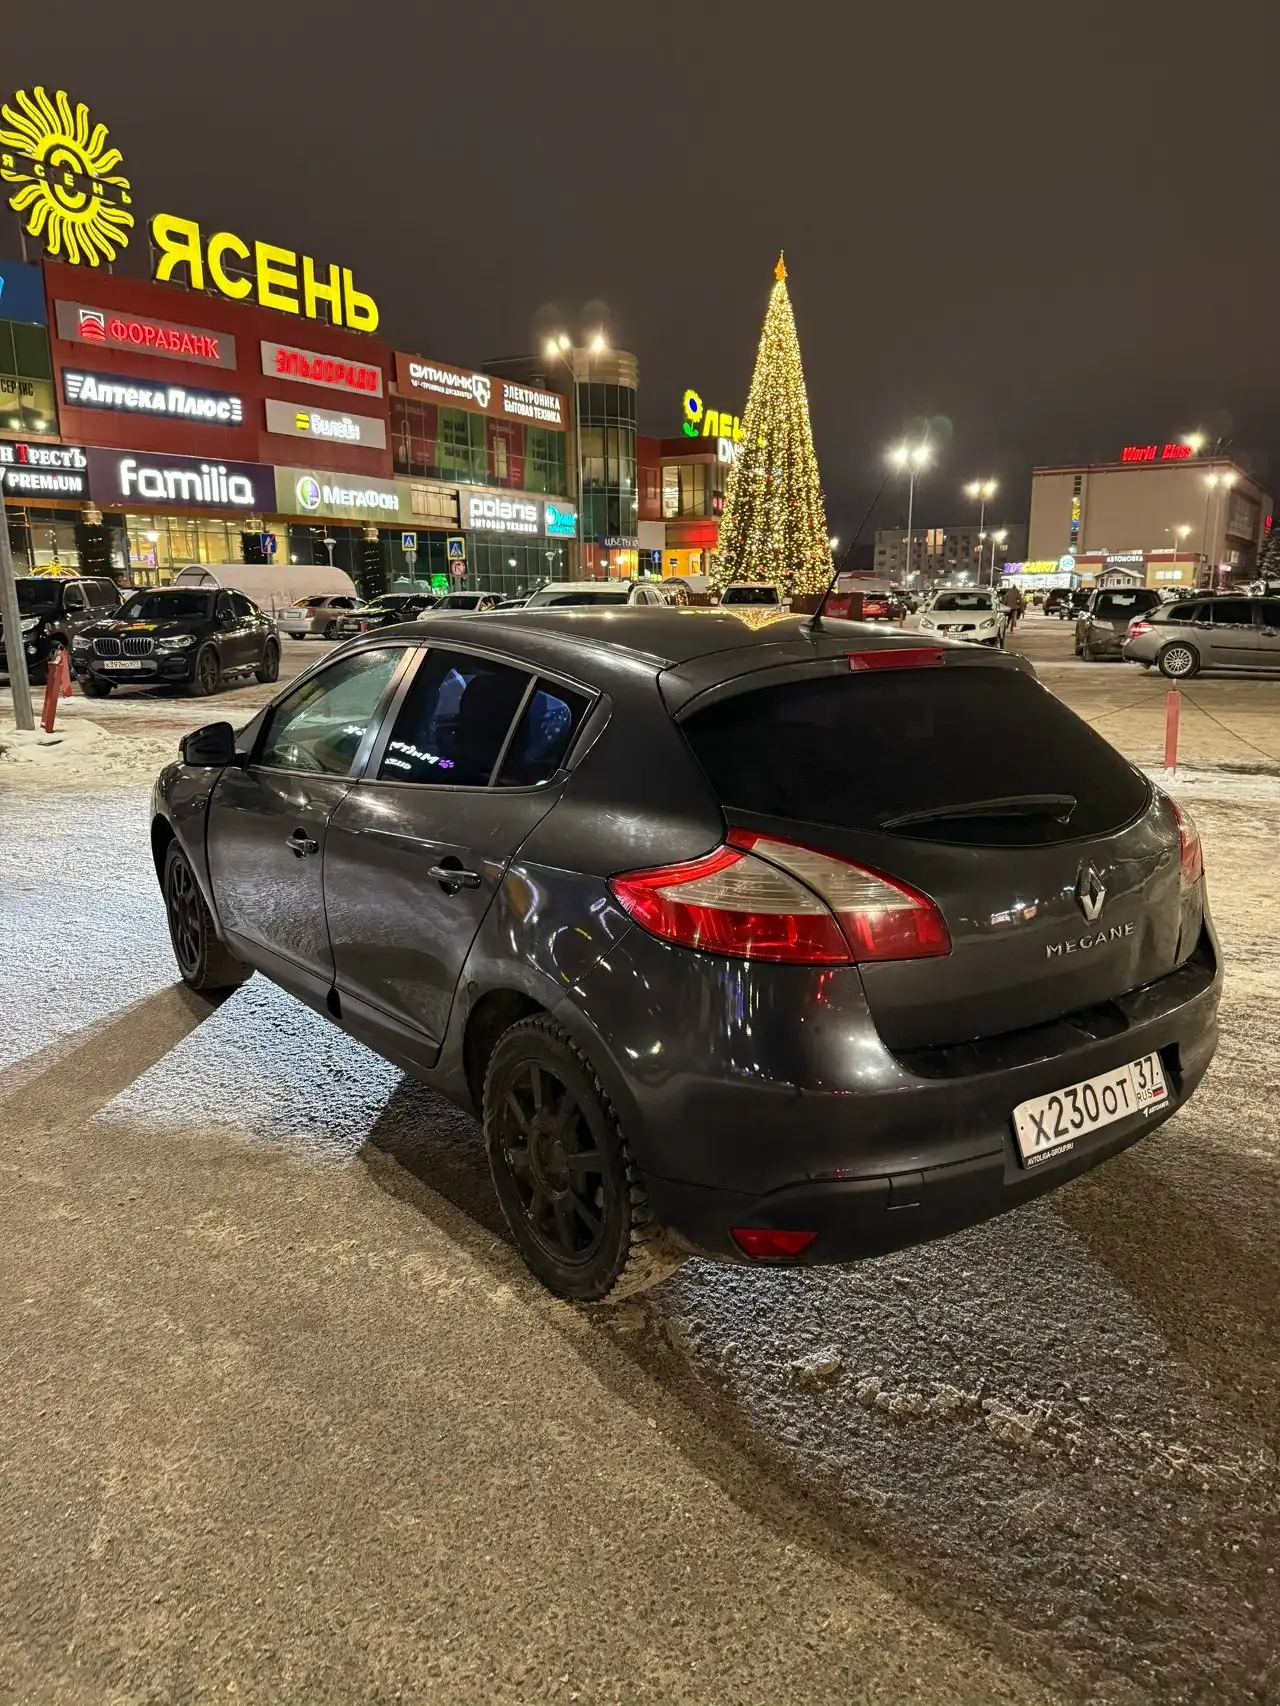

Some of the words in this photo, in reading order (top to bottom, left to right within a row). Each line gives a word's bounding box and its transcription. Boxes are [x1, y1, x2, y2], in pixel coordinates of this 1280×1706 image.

[1, 153, 132, 204] ЯСЕНЬ
[152, 213, 380, 333] ЯСЕНЬ
[110, 319, 220, 359] ФОРАБАНК
[275, 348, 378, 392] ЭЛЬДОРАДО
[409, 363, 473, 391] СИТИЛИНК
[503, 384, 560, 410] ЭЛЕКТРОНИКА
[503, 400, 534, 418] БЫТОВАЯ
[534, 405, 562, 424] ТЕХНИКА
[1122, 445, 1157, 461] World
[1161, 442, 1193, 460] Class
[120, 458, 256, 504] familia
[470, 499, 537, 522] polaris
[470, 518, 506, 531] БЫТОВАЯ
[507, 521, 538, 533] ТЕХНИКА
[1045, 922, 1135, 959] MEGANE
[1134, 1056, 1155, 1089] 37
[1136, 1089, 1153, 1102] RUS
